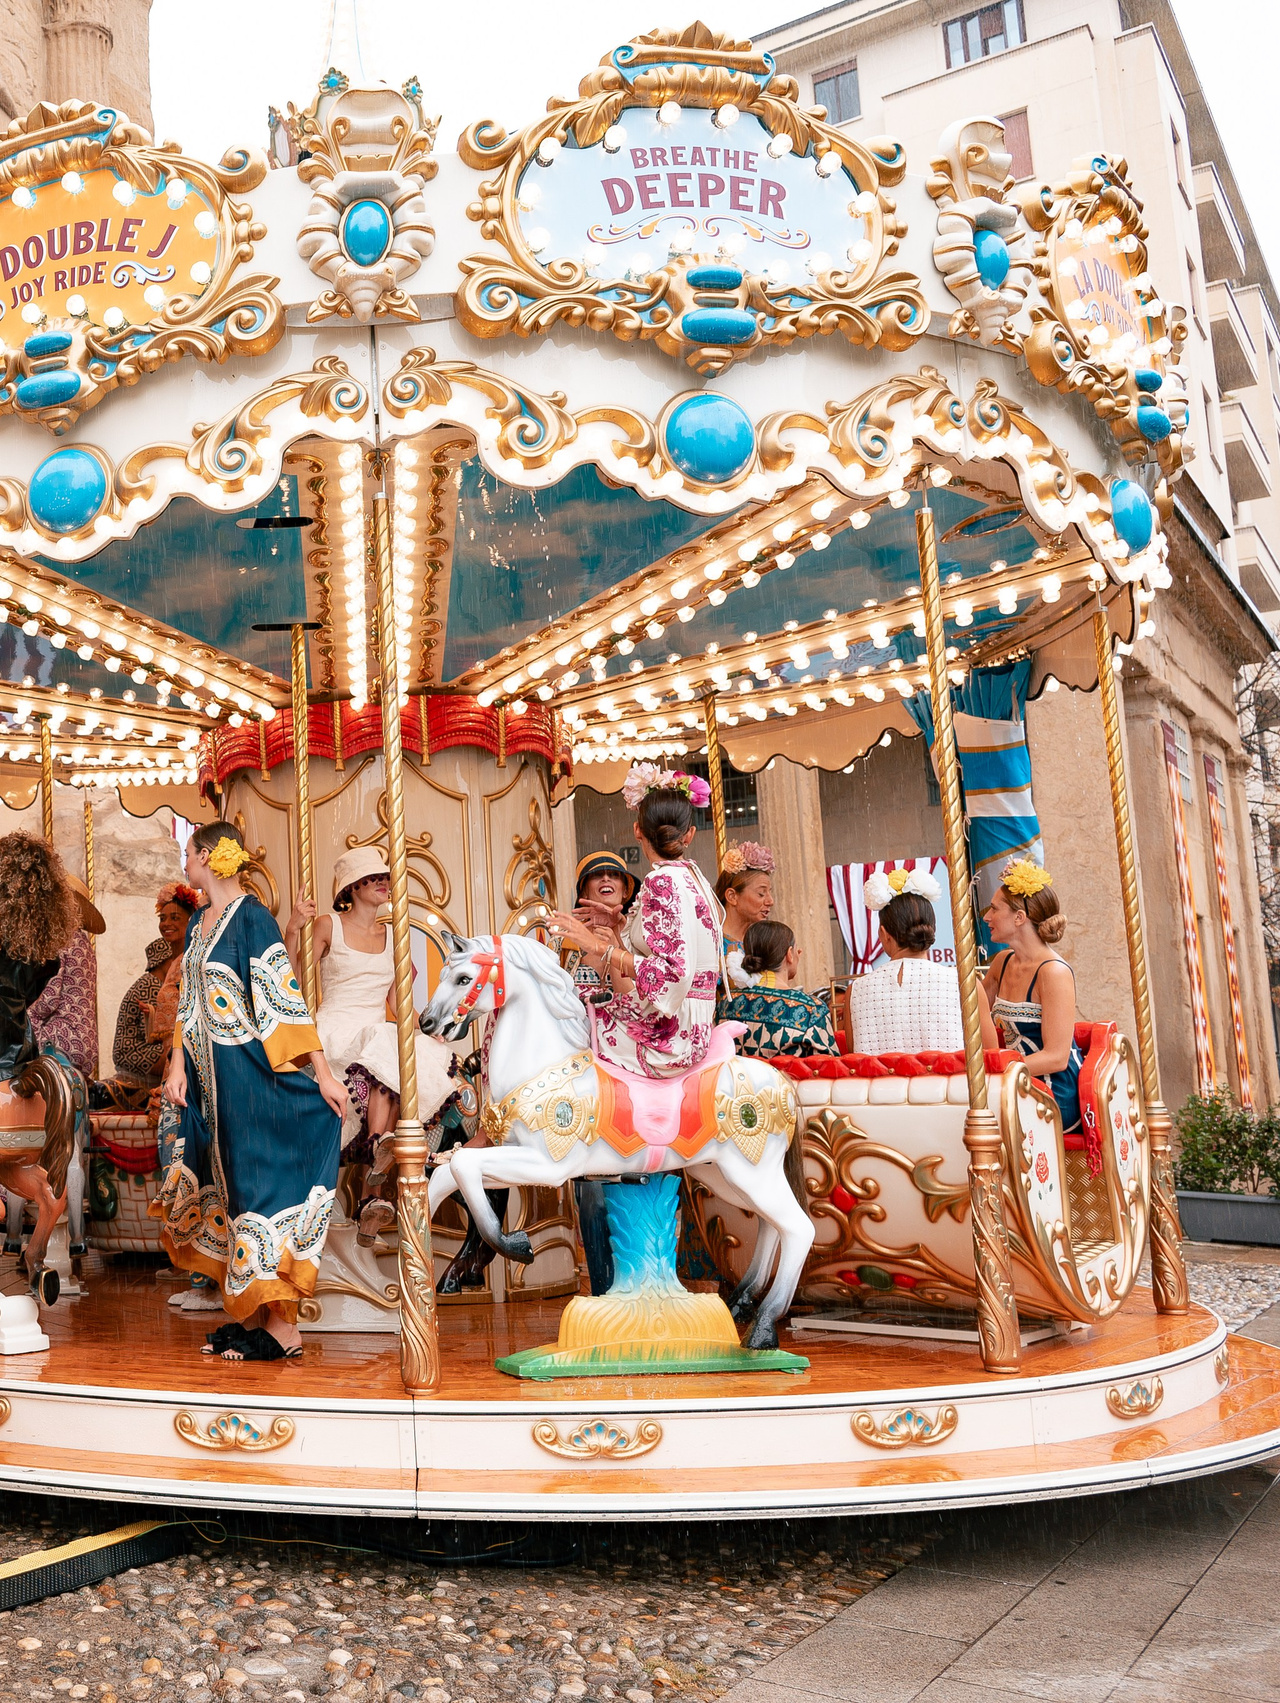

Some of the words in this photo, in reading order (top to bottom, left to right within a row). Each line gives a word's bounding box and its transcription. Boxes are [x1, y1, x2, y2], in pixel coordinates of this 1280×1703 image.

[629, 145, 759, 173] BREATHE
[600, 172, 788, 221] DEEPER
[147, 223, 179, 260] J
[11, 277, 47, 310] JOY
[54, 261, 107, 292] RIDE
[1073, 261, 1094, 299] LA
[1102, 301, 1115, 326] JOY
[623, 848, 638, 862] 12
